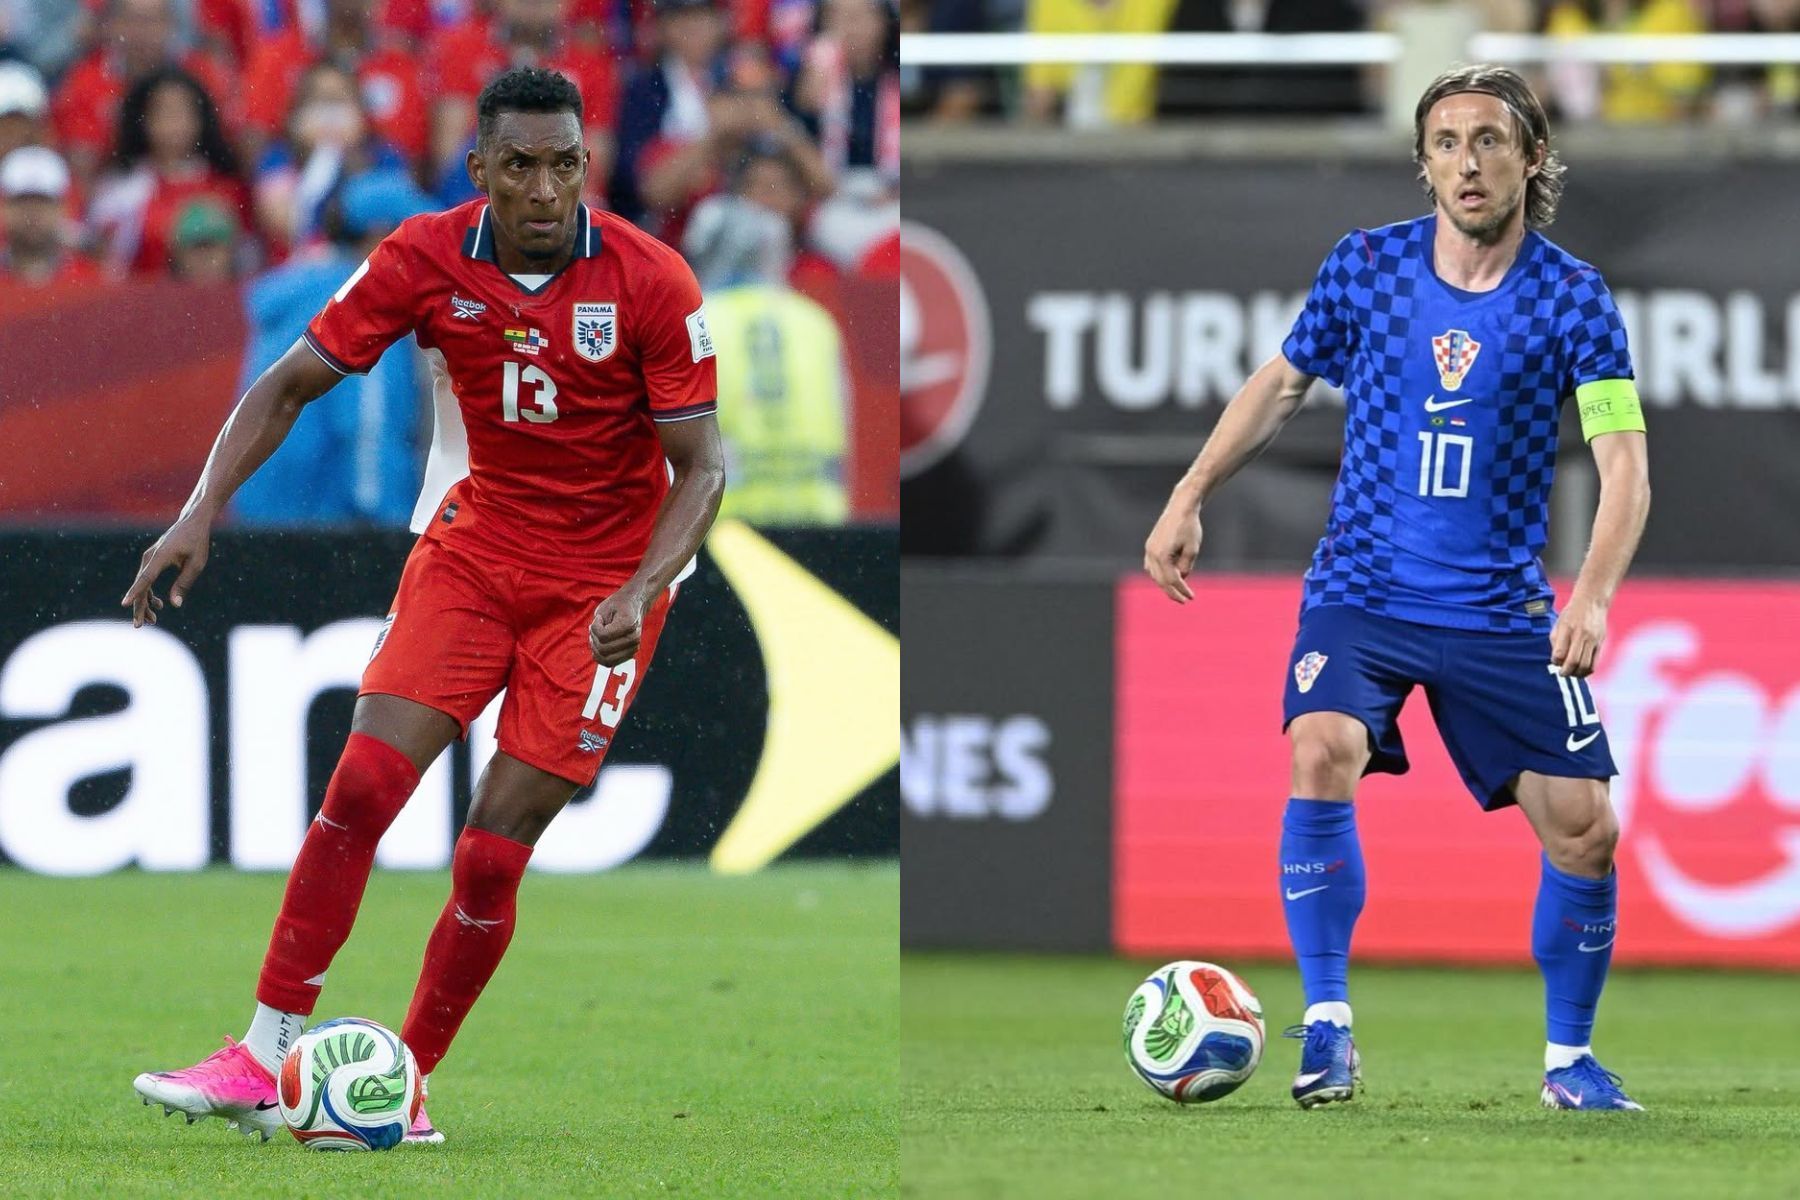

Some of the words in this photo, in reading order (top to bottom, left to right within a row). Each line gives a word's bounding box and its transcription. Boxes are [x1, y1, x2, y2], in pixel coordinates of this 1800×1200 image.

[451, 296, 487, 312] Reebok
[503, 361, 558, 423] 13
[1418, 431, 1473, 498] 10
[581, 659, 636, 729] 13
[1547, 664, 1600, 727] 10
[580, 730, 608, 745] Reebok
[1284, 863, 1325, 874] HNS
